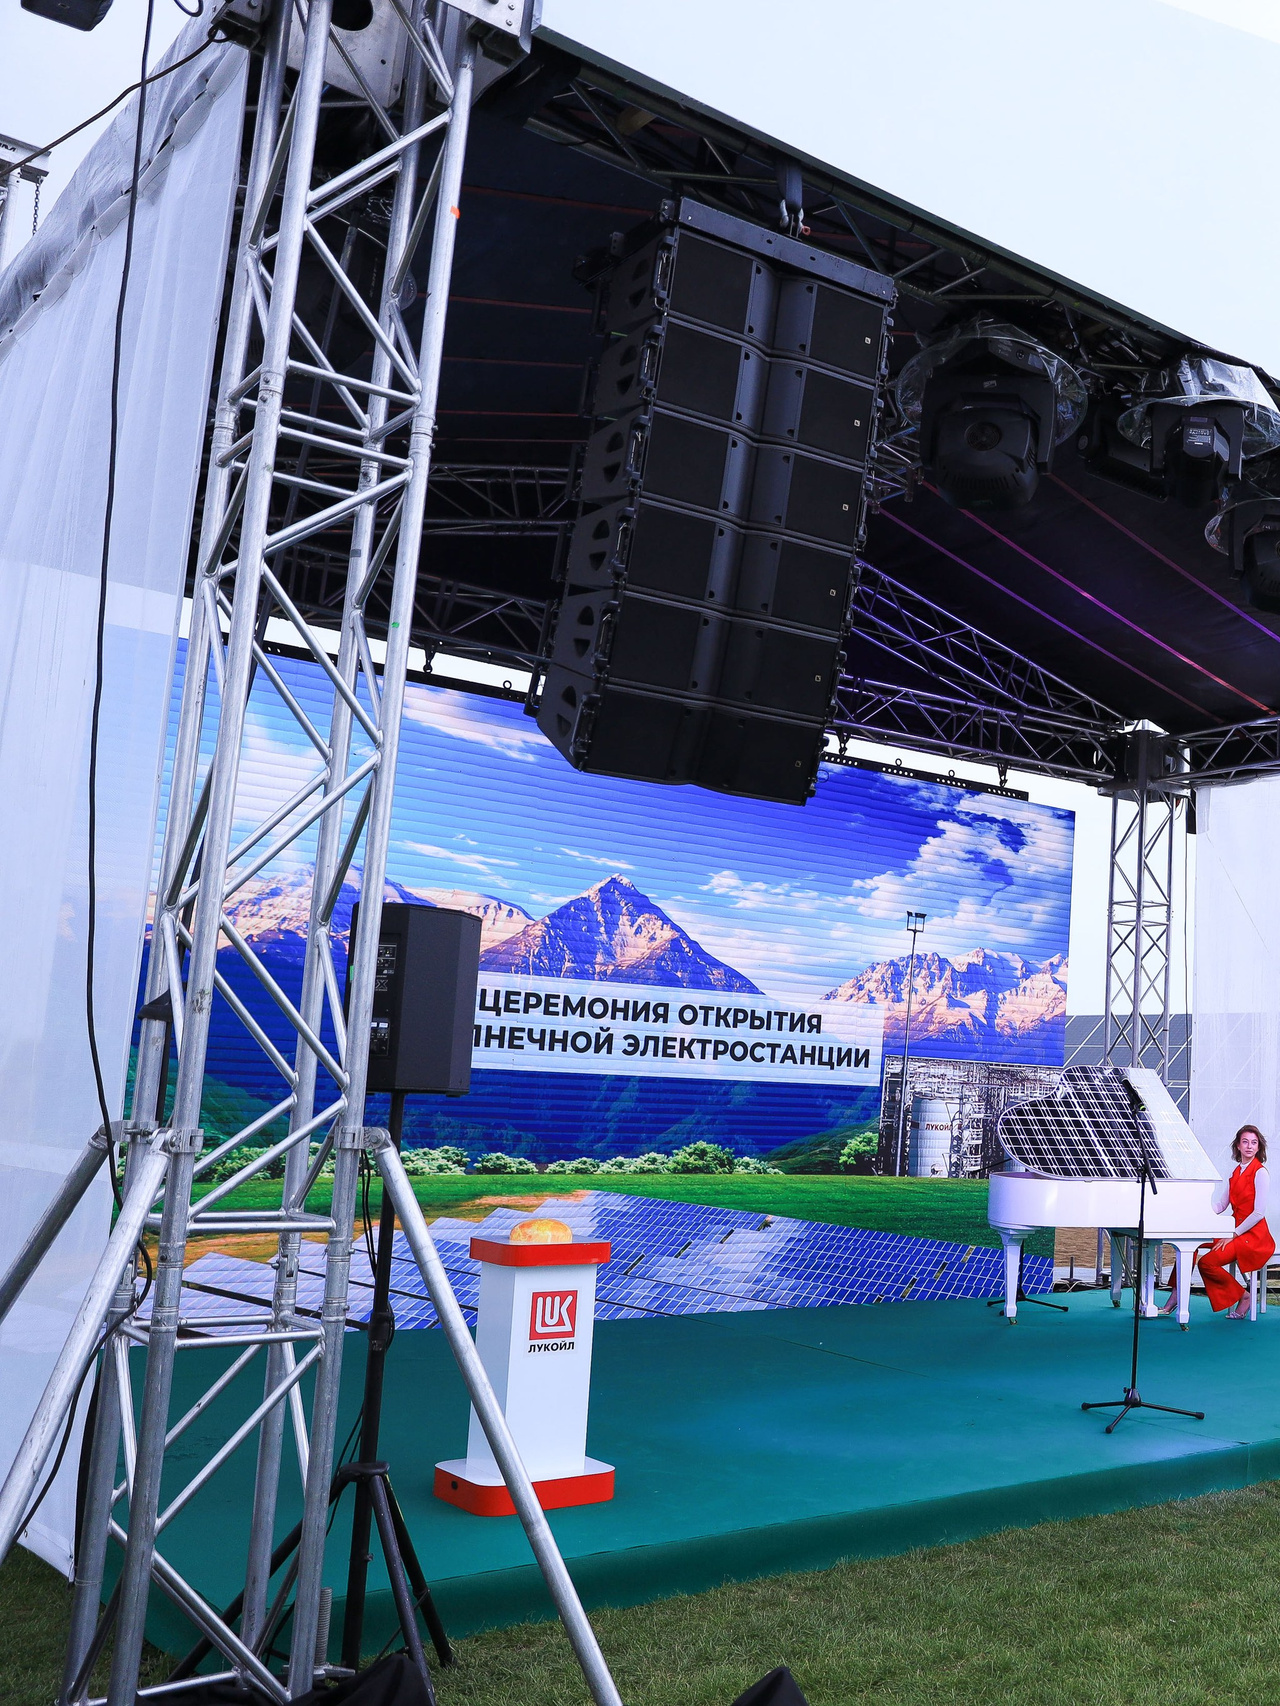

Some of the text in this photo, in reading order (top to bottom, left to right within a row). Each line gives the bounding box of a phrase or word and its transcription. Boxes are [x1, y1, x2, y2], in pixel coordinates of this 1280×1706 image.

[478, 988, 822, 1034] ЦЕРЕМОНИЯ ОТКРЫТИЯ
[621, 1034, 870, 1070] ЭЛЕКТРОСТАНЦИИ
[528, 1340, 575, 1353] ЛУКОЙЛ
